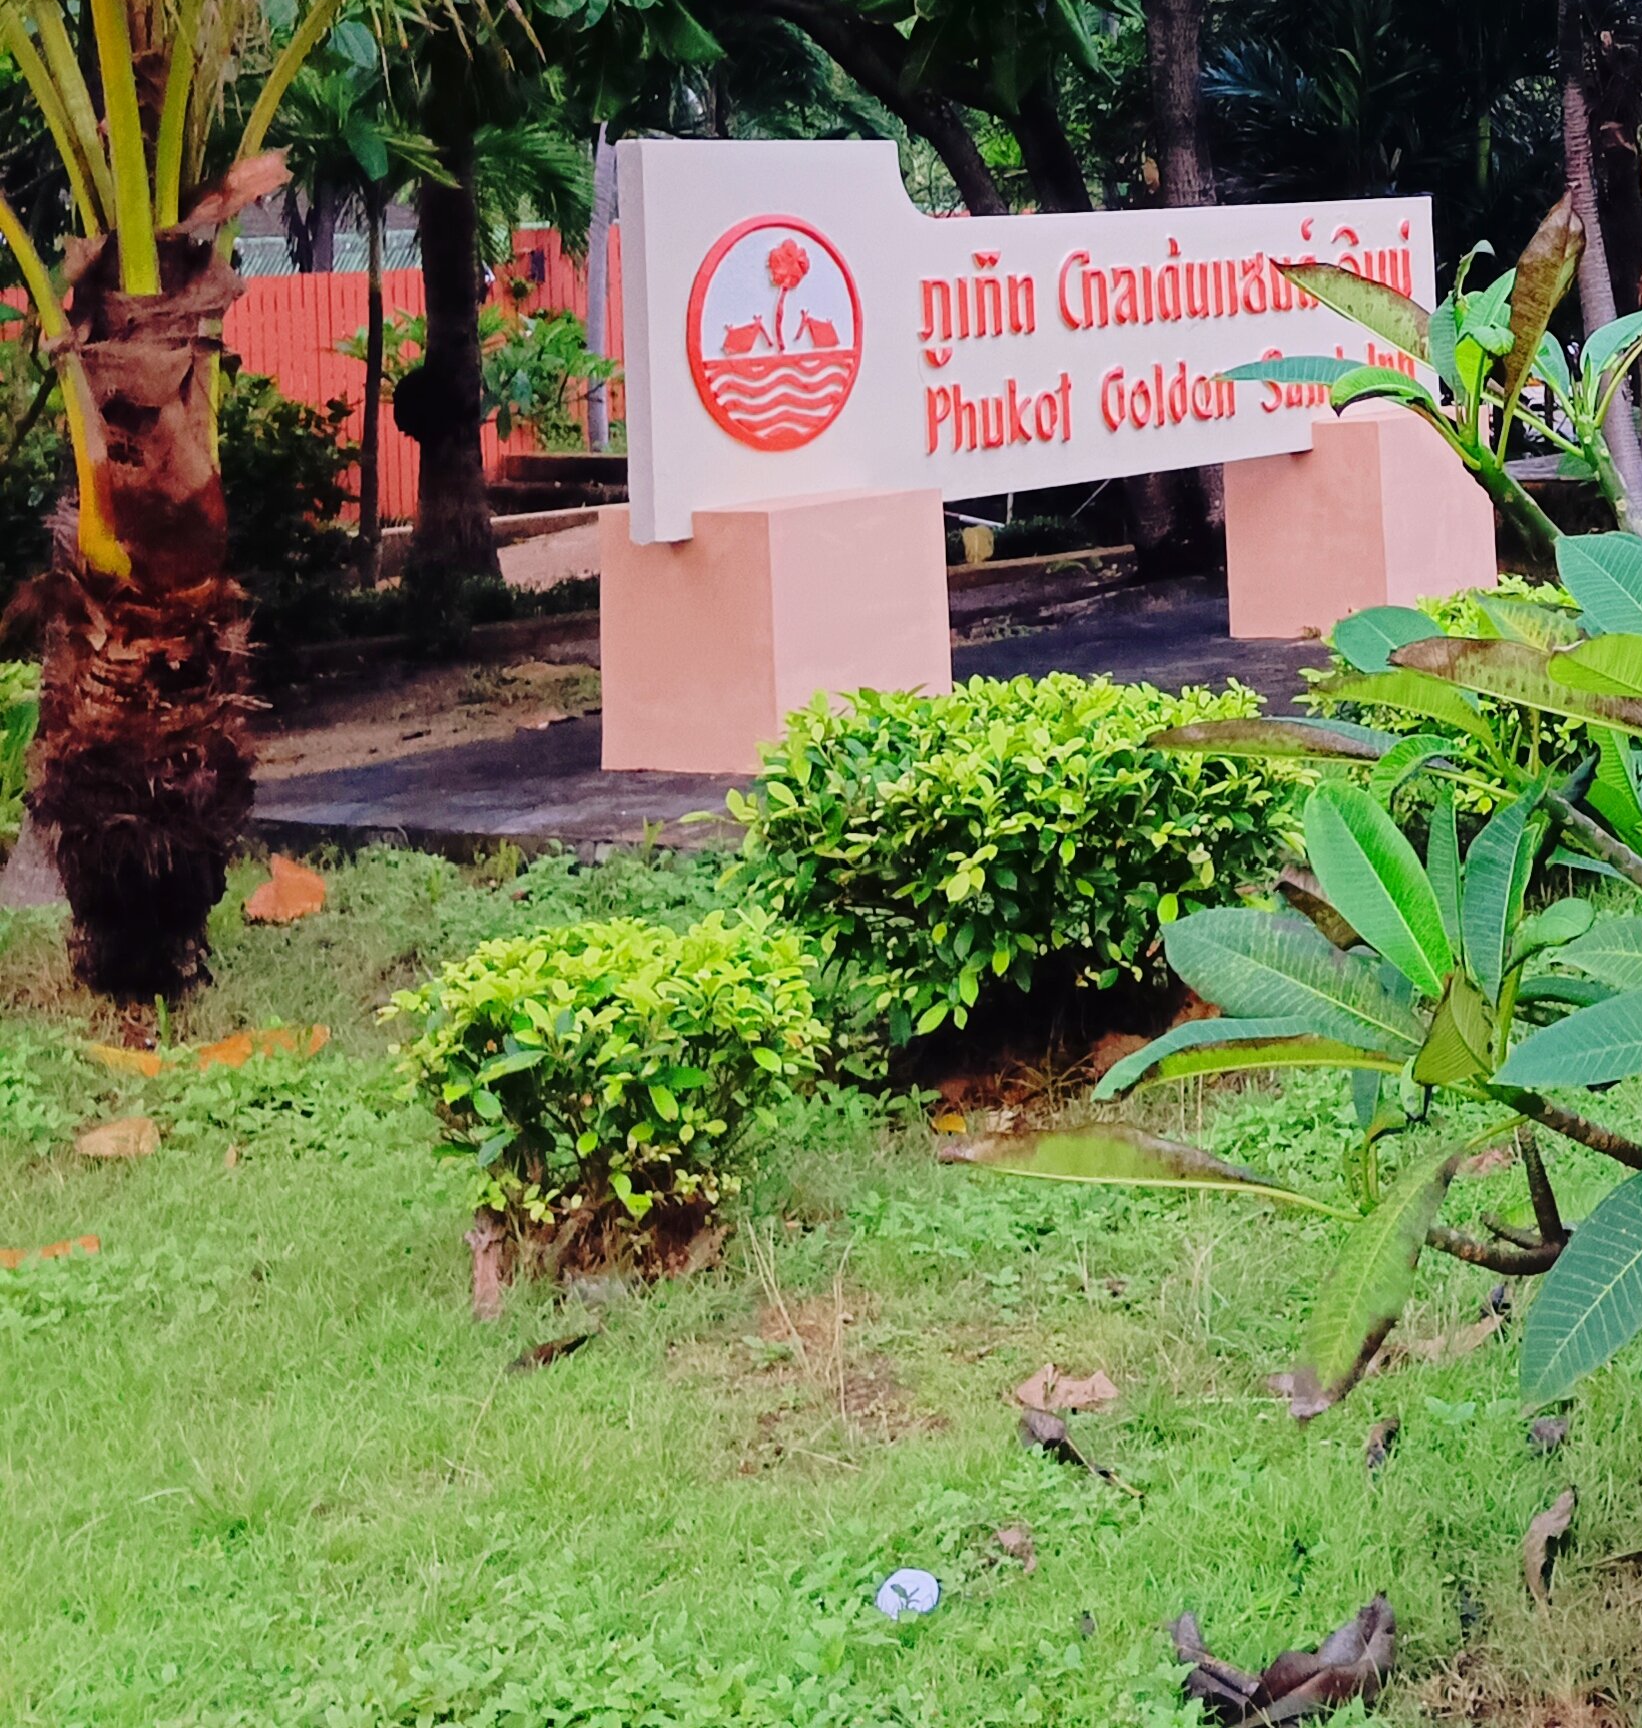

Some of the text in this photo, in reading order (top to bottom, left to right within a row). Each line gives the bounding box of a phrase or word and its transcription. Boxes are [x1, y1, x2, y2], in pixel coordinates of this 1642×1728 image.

[917, 249, 1036, 368] ภูเก็ต
[925, 372, 1072, 456] Phuket
[1101, 360, 1236, 432] Golden
[1261, 344, 1344, 414] San
